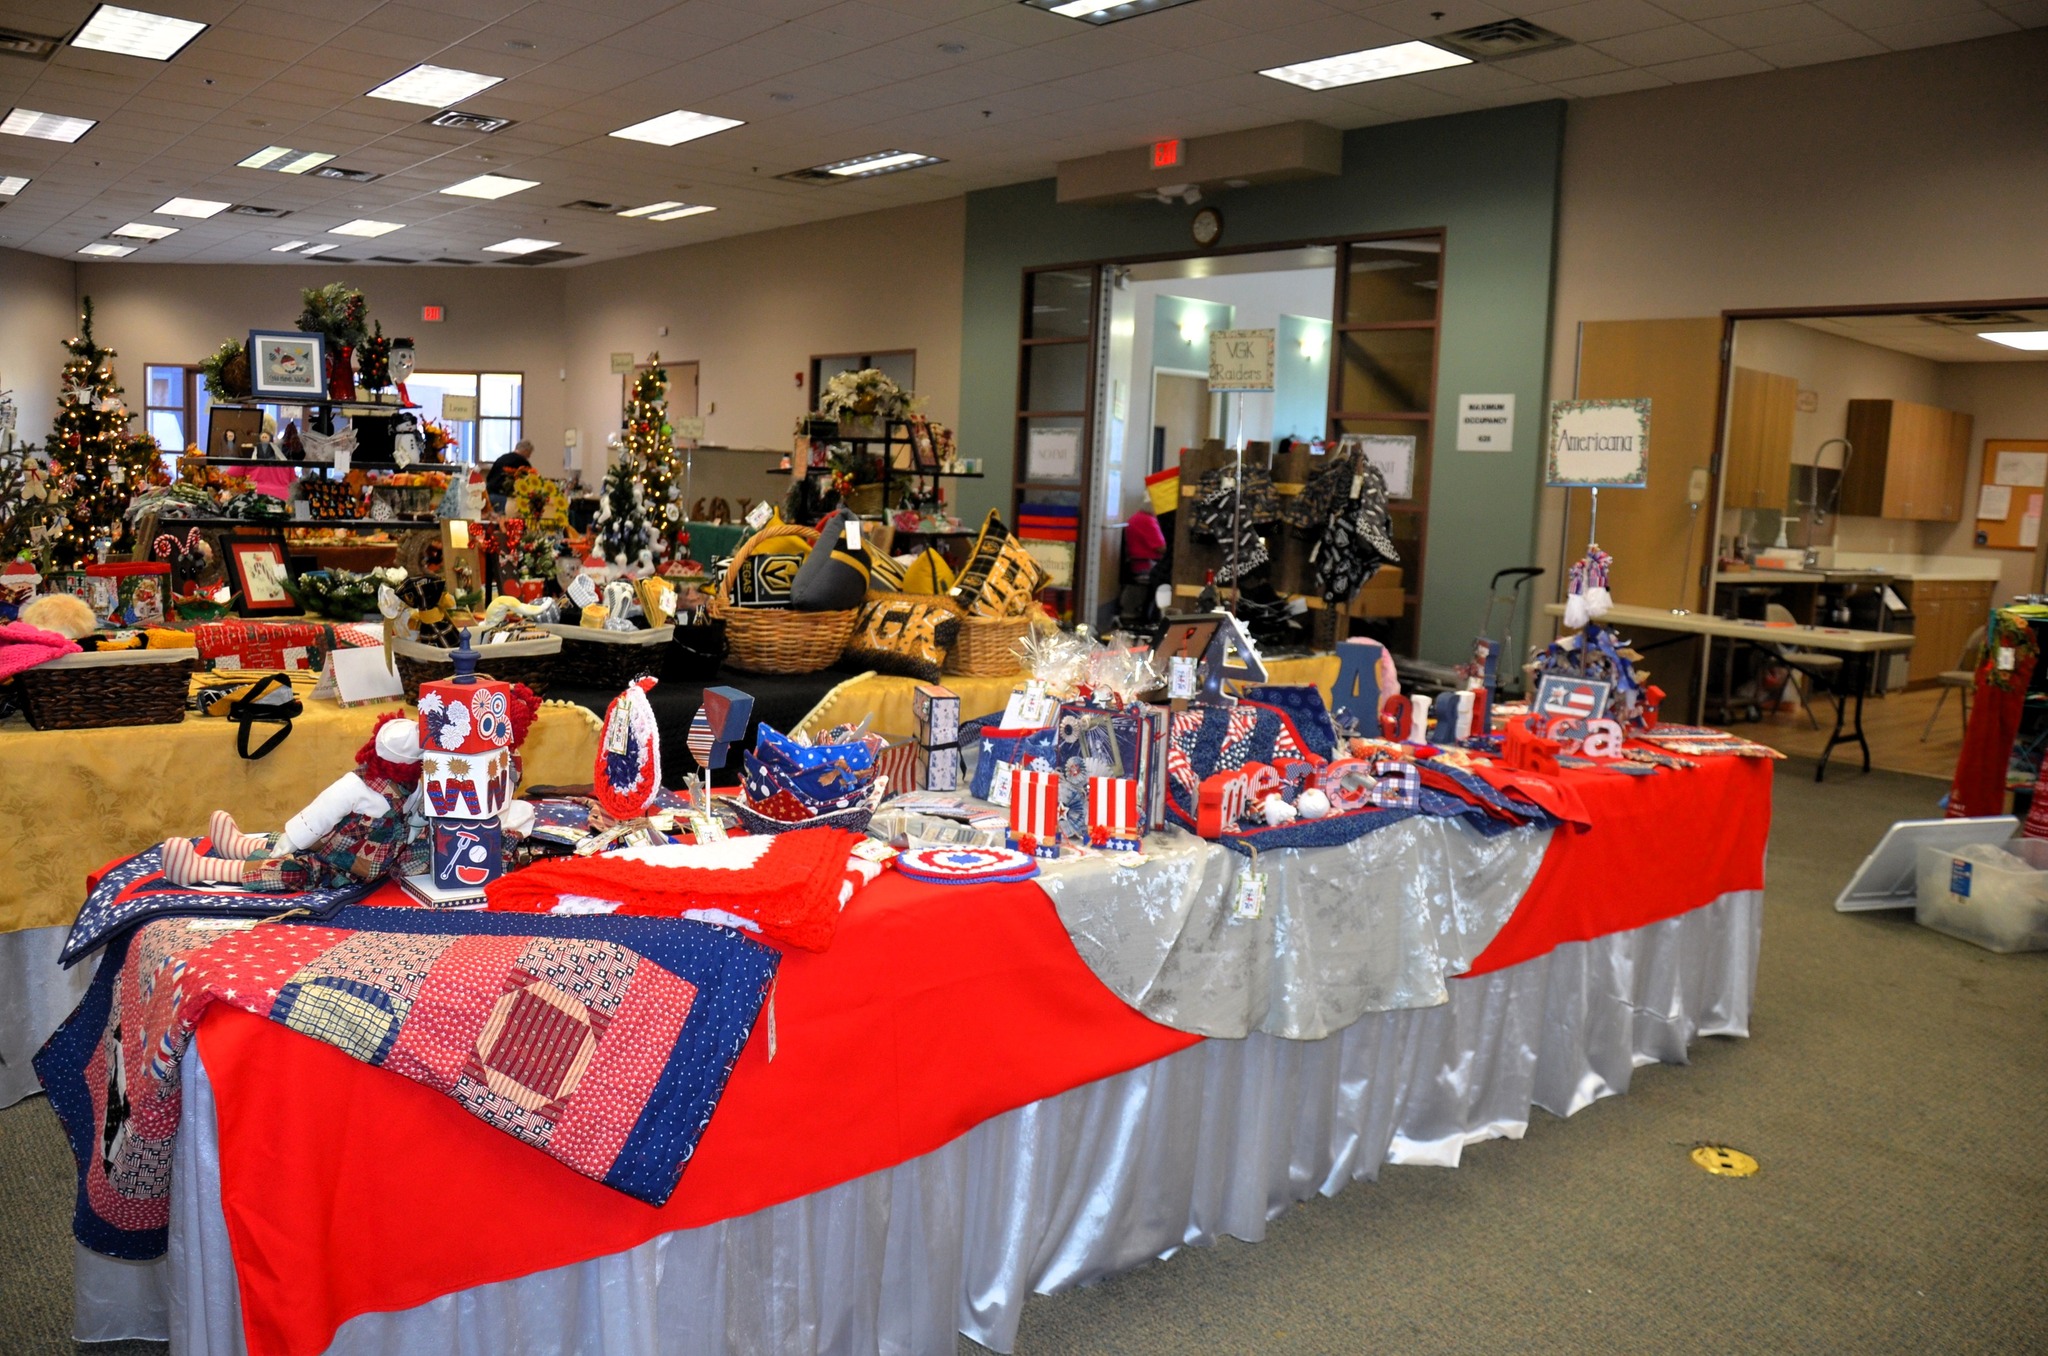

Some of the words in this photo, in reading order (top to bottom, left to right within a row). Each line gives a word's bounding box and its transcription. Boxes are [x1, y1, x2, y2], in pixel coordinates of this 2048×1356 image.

[1154, 140, 1178, 167] EXIT
[1226, 341, 1255, 358] VGK
[1216, 363, 1262, 380] Raiders
[1557, 429, 1633, 452] Americana
